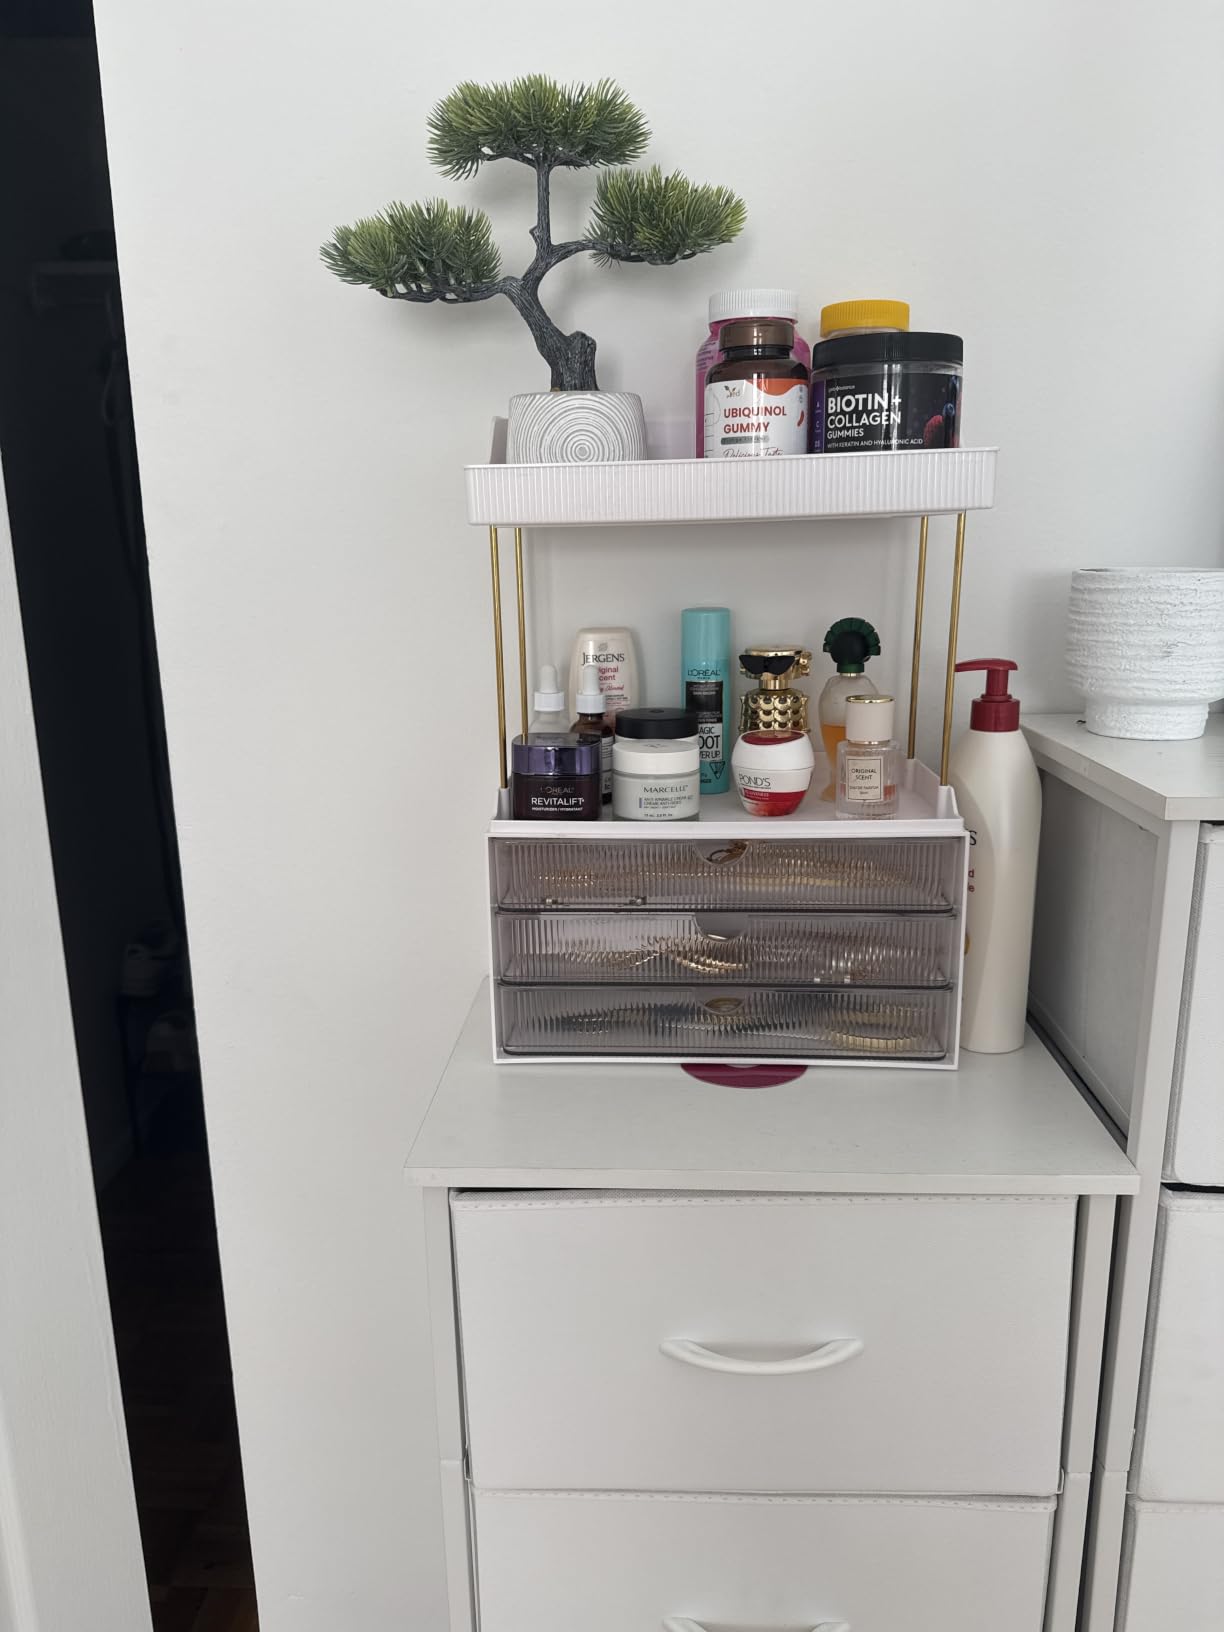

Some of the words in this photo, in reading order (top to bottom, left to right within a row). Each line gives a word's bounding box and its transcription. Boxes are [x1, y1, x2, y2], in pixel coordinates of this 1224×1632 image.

[828, 393, 902, 414] BIOTIN+
[724, 406, 787, 418] UBIQUINOL
[827, 411, 901, 429] COLLAGEN
[724, 422, 770, 434] GUMMY
[827, 429, 864, 439] GUMMIES
[838, 440, 860, 448] KERATIN
[581, 652, 625, 666] JERGENS
[699, 726, 715, 735] AGIC
[699, 735, 721, 750] OOT
[738, 773, 771, 787] POND'S
